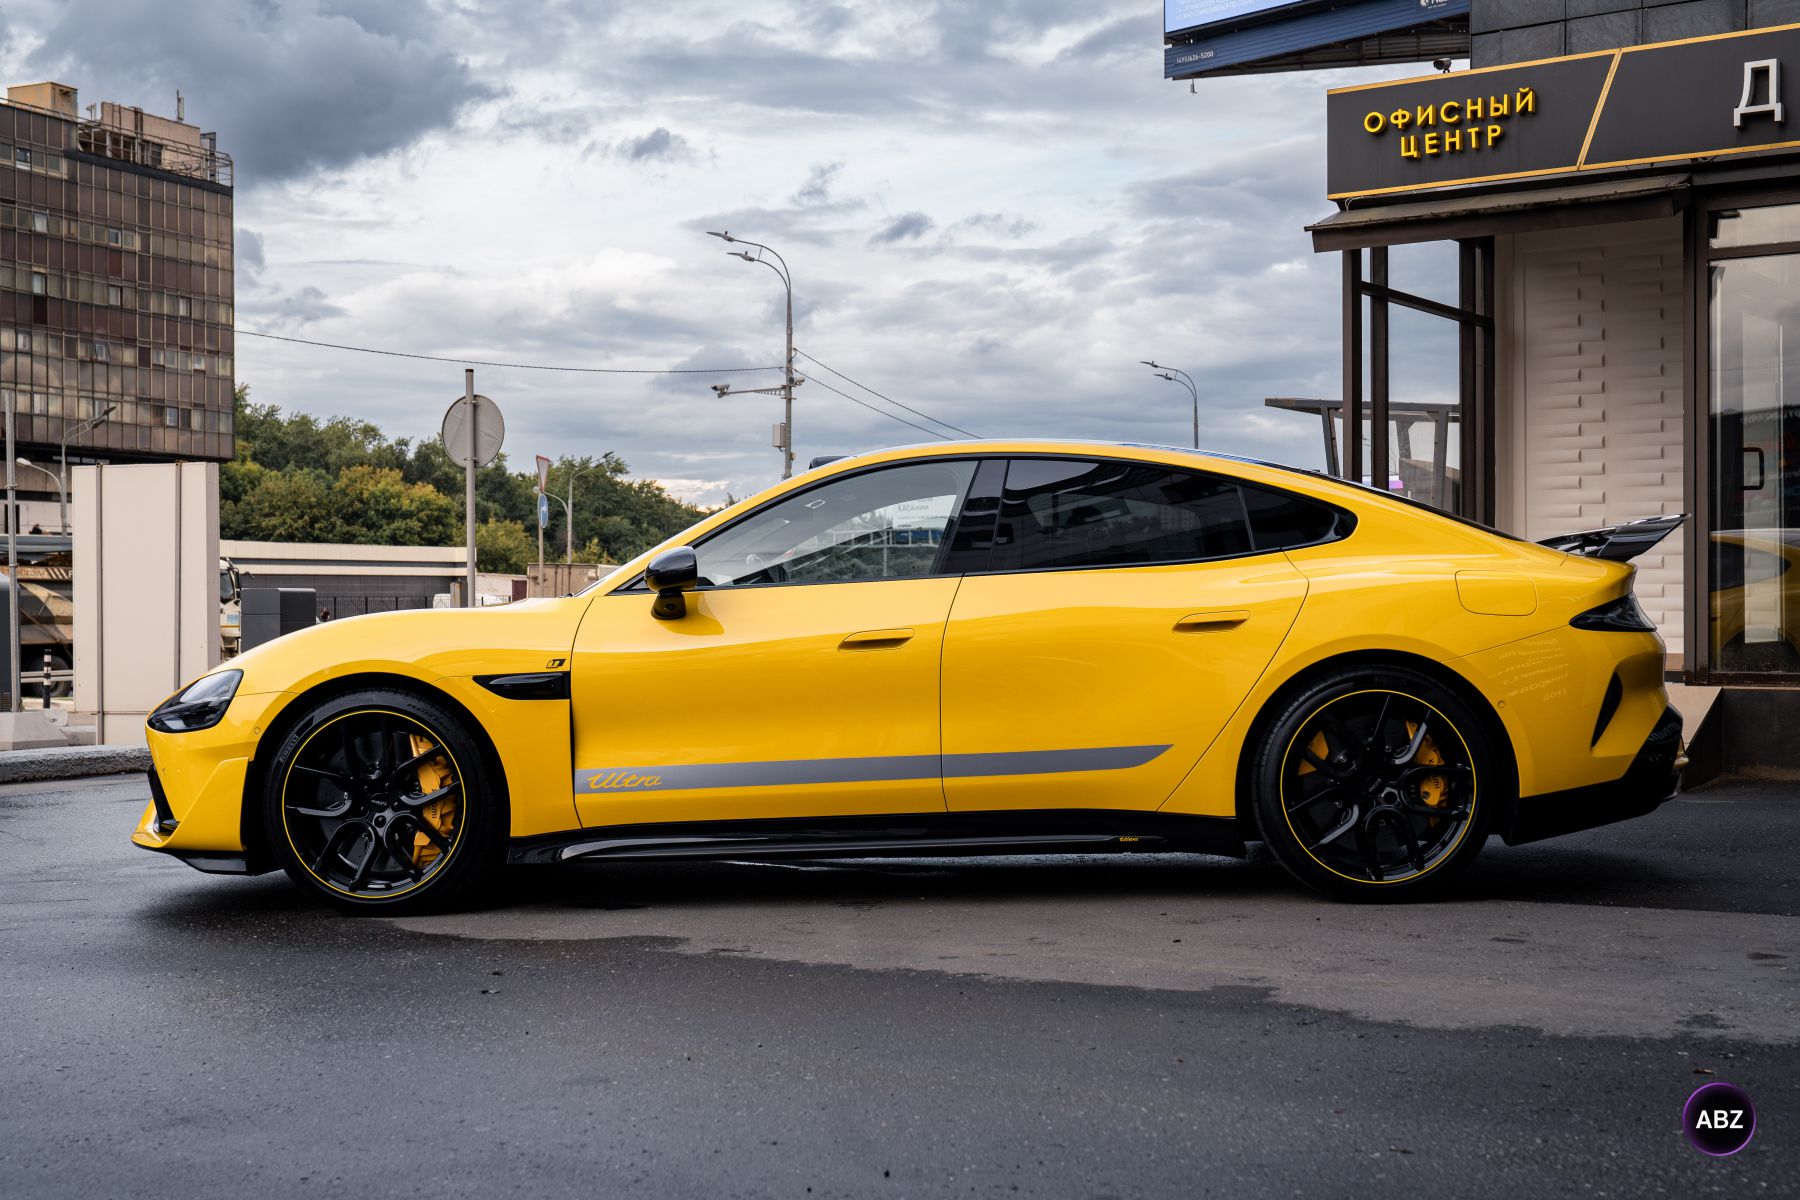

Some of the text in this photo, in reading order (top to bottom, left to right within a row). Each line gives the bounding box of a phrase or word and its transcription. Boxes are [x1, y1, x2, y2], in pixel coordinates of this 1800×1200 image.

[1363, 87, 1537, 134] ОФИСНЫЙ
[1733, 58, 1785, 128] Д
[1400, 125, 1505, 161] ЦЕНТР
[587, 771, 662, 789] Ultra
